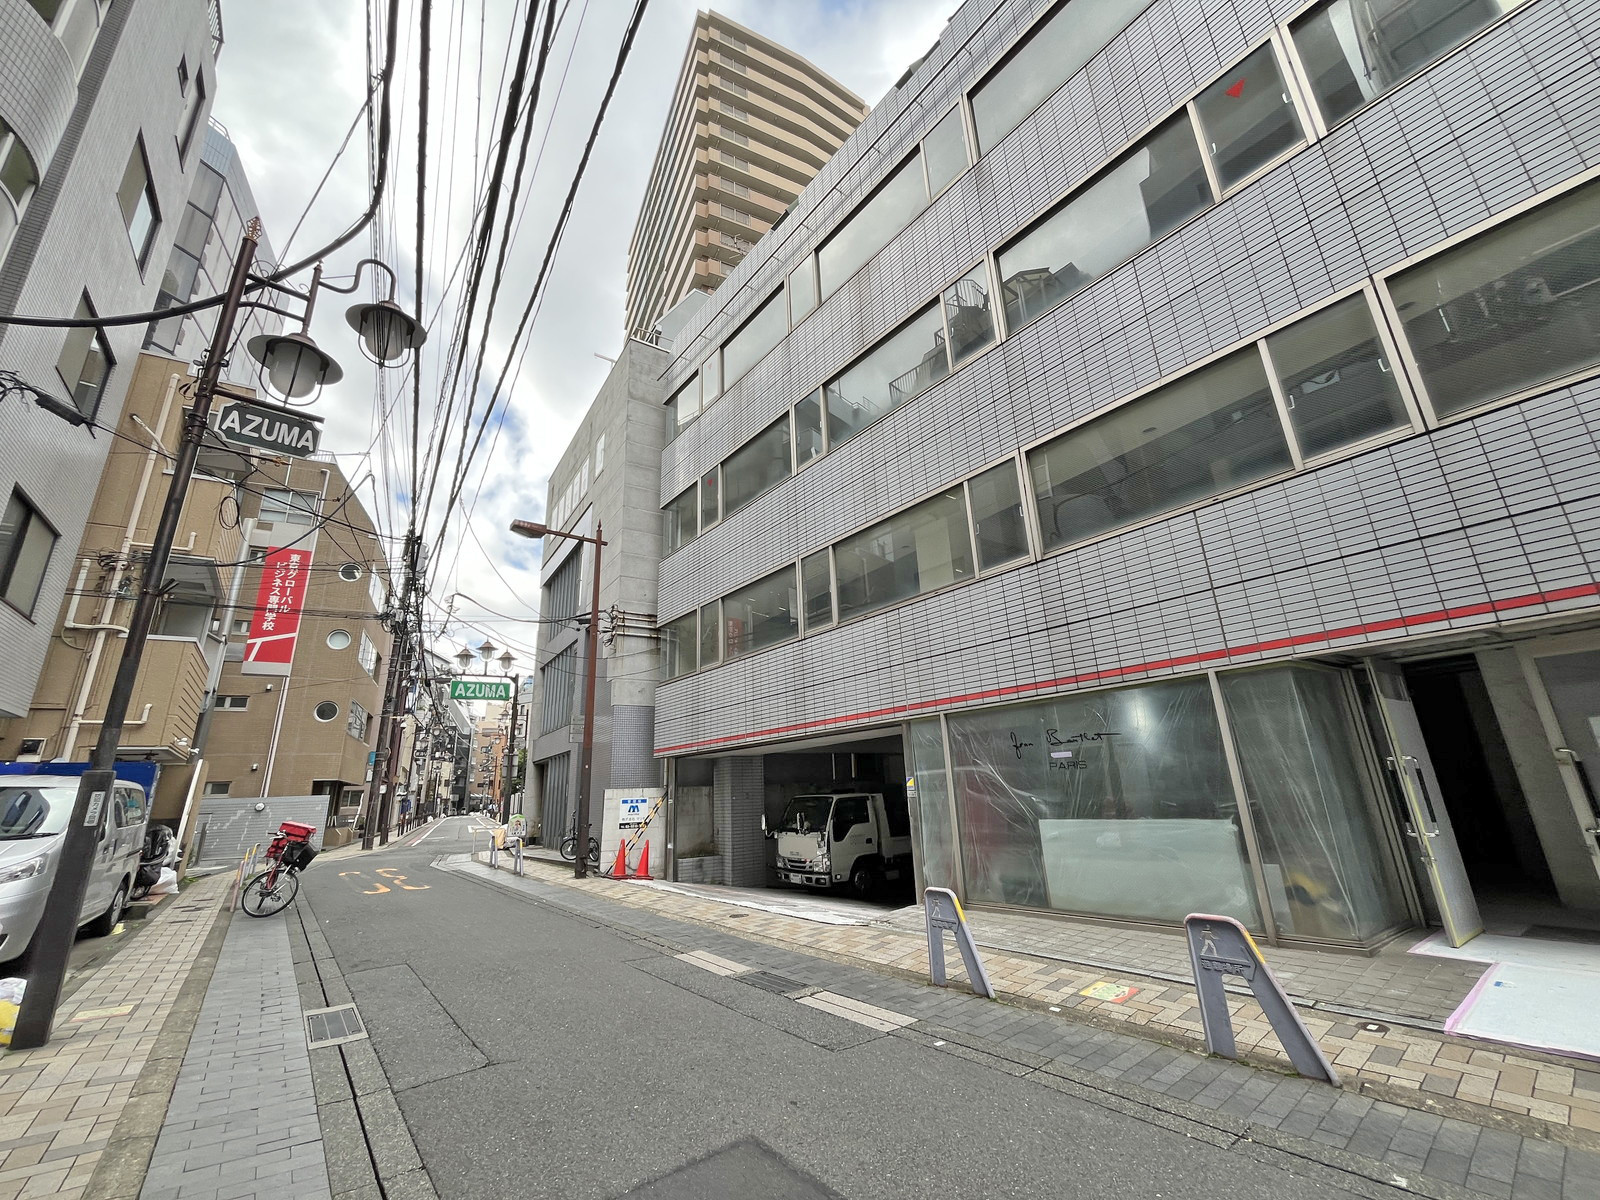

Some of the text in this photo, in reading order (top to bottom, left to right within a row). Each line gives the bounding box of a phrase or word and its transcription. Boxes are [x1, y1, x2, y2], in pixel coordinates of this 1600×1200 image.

[221, 410, 314, 452] AZUMA
[455, 683, 506, 698] AZUMA
[1049, 760, 1088, 770] PARIS
